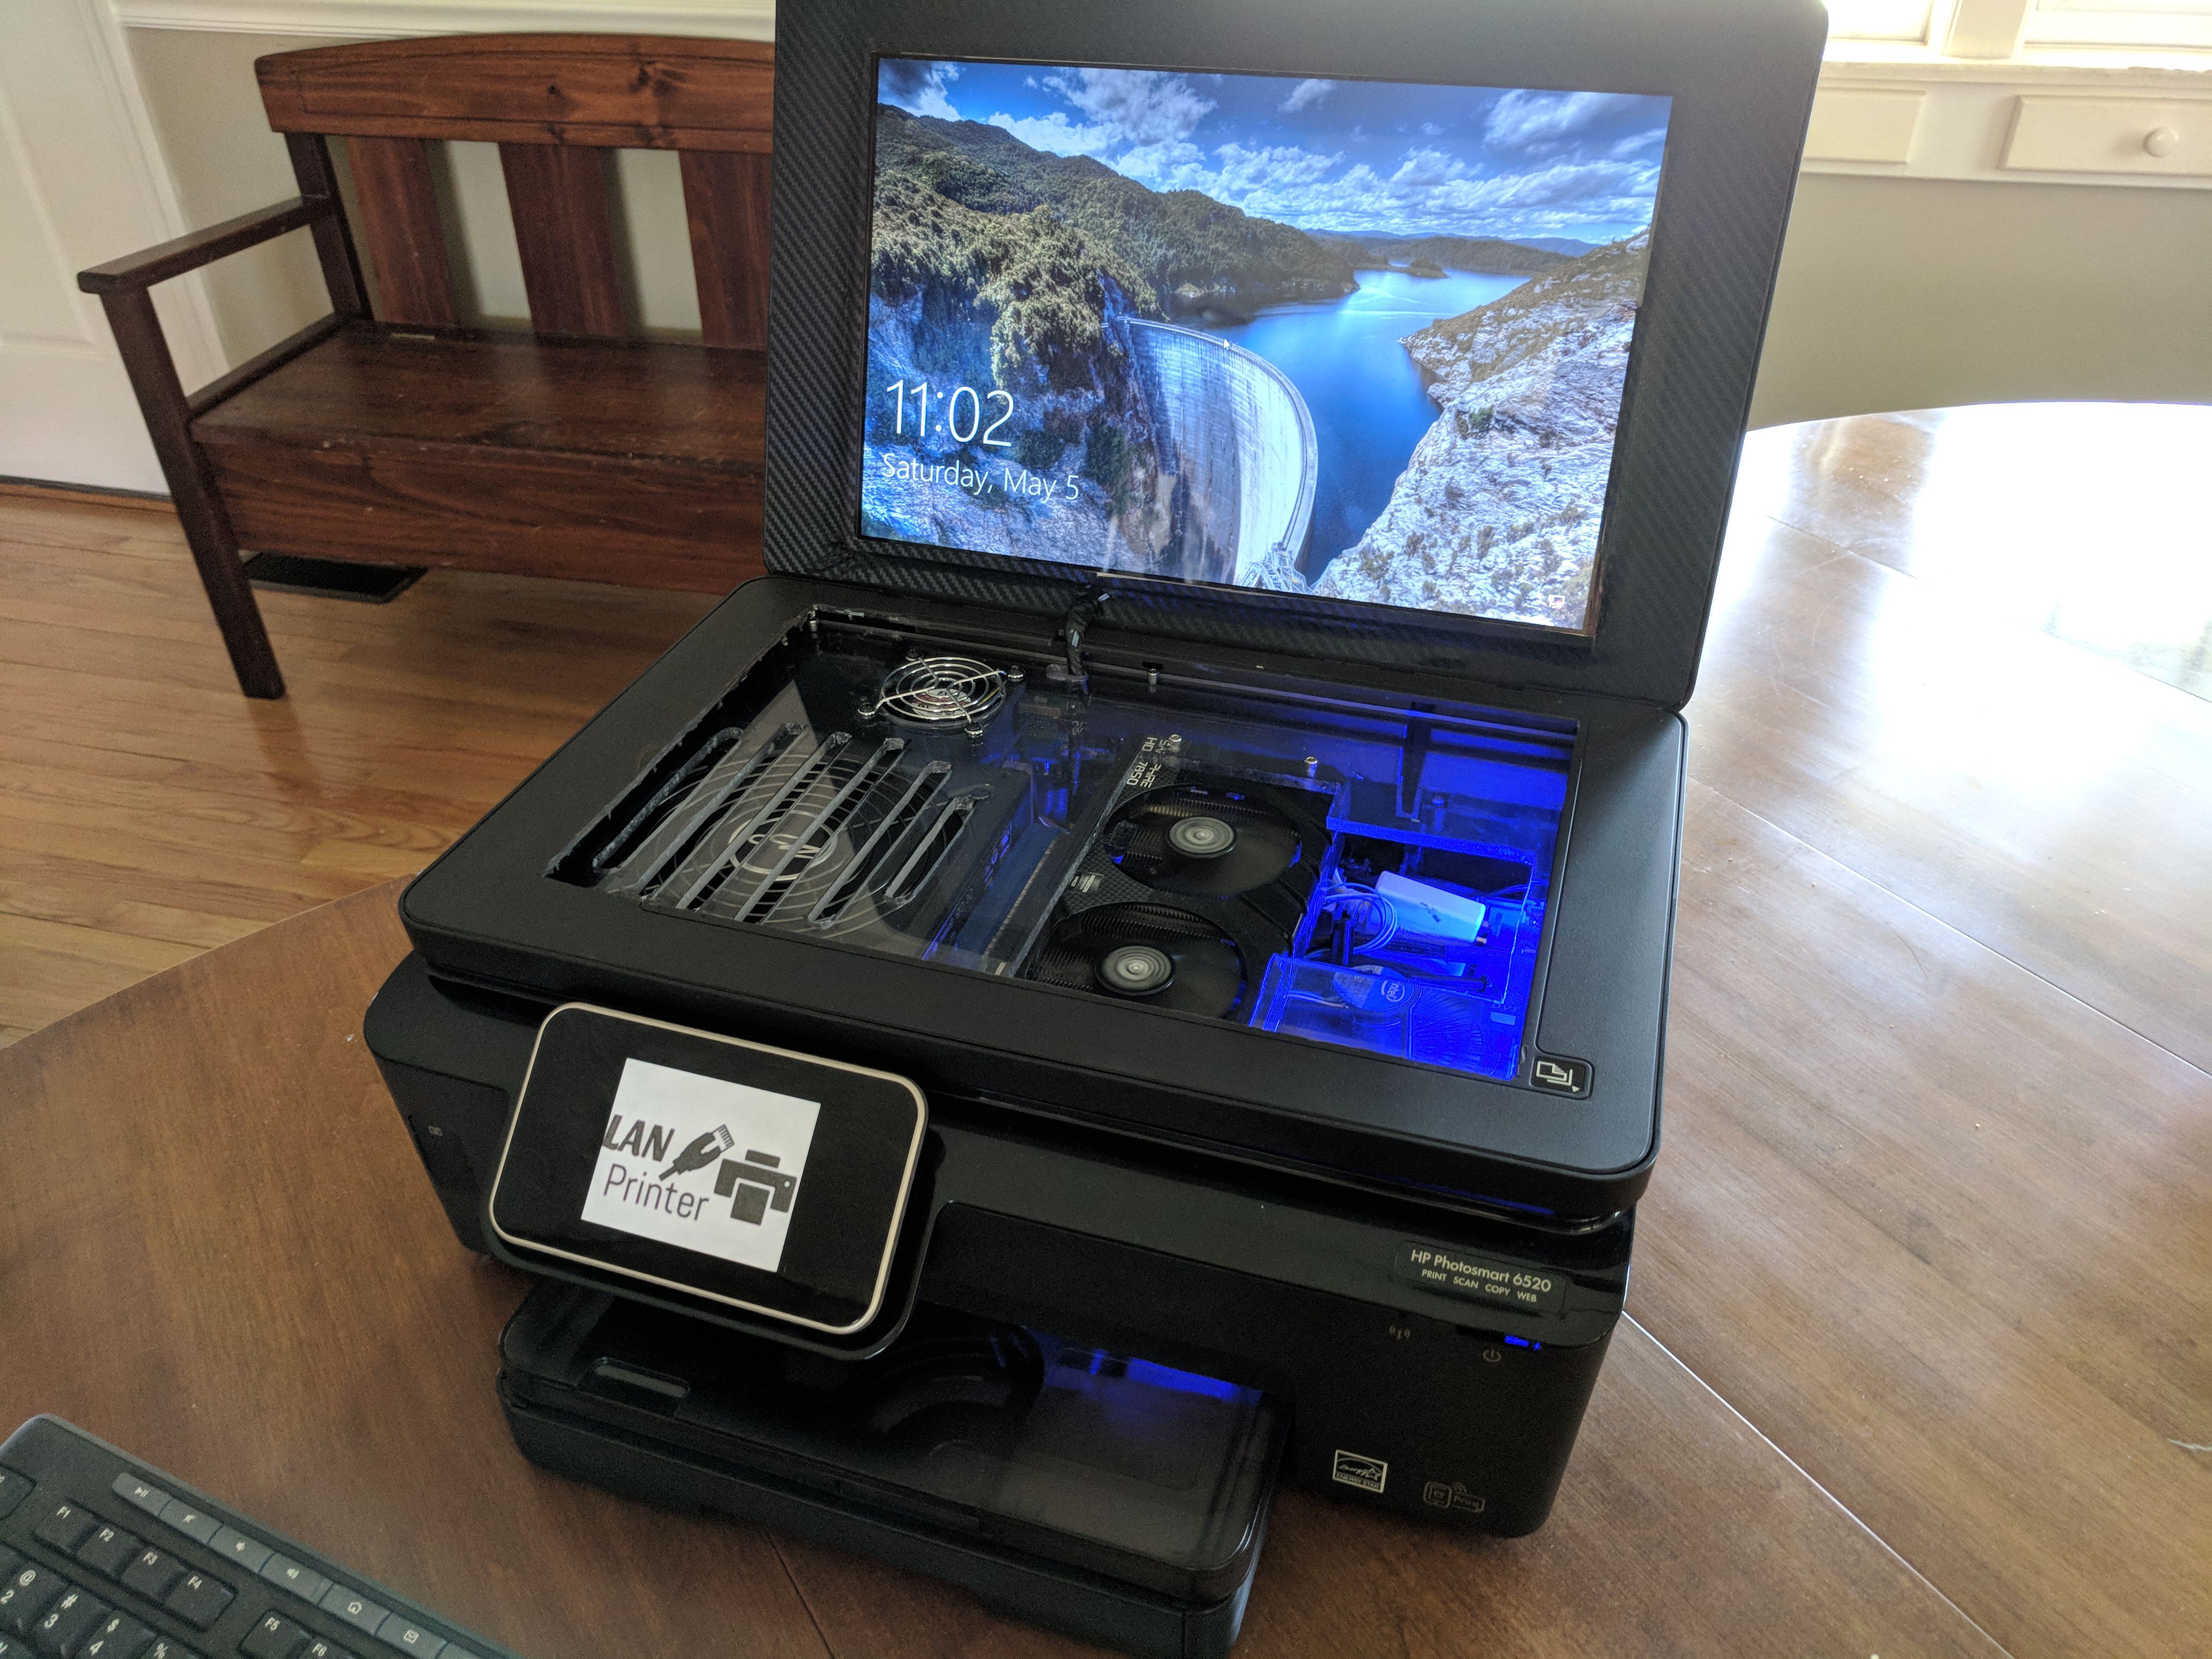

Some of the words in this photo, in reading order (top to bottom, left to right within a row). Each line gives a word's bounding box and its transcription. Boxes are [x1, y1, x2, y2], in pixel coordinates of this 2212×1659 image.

[886, 379, 1014, 447] 11:02
[882, 453, 993, 496] Saturday,
[1004, 467, 1056, 503] May
[1066, 475, 1079, 500] 5
[1142, 737, 1157, 752] HD
[1126, 762, 1149, 785] 7850
[603, 1114, 675, 1162] LAN
[603, 1163, 709, 1221] Printer
[1411, 1249, 1432, 1264] HP
[1434, 1254, 1510, 1283] Photosmart
[1513, 1273, 1551, 1292] 6520
[1421, 1268, 1447, 1281] PRINT
[1453, 1276, 1479, 1289] SCAN
[1485, 1283, 1510, 1296] COPY
[1517, 1291, 1537, 1302] WEB
[56, 1505, 71, 1519] F1
[99, 1528, 114, 1542] F2
[143, 1551, 158, 1566] F3
[187, 1575, 203, 1590] F4
[1, 1590, 14, 1605] 2
[44, 1613, 59, 1629] 3
[90, 1640, 104, 1656] 4
